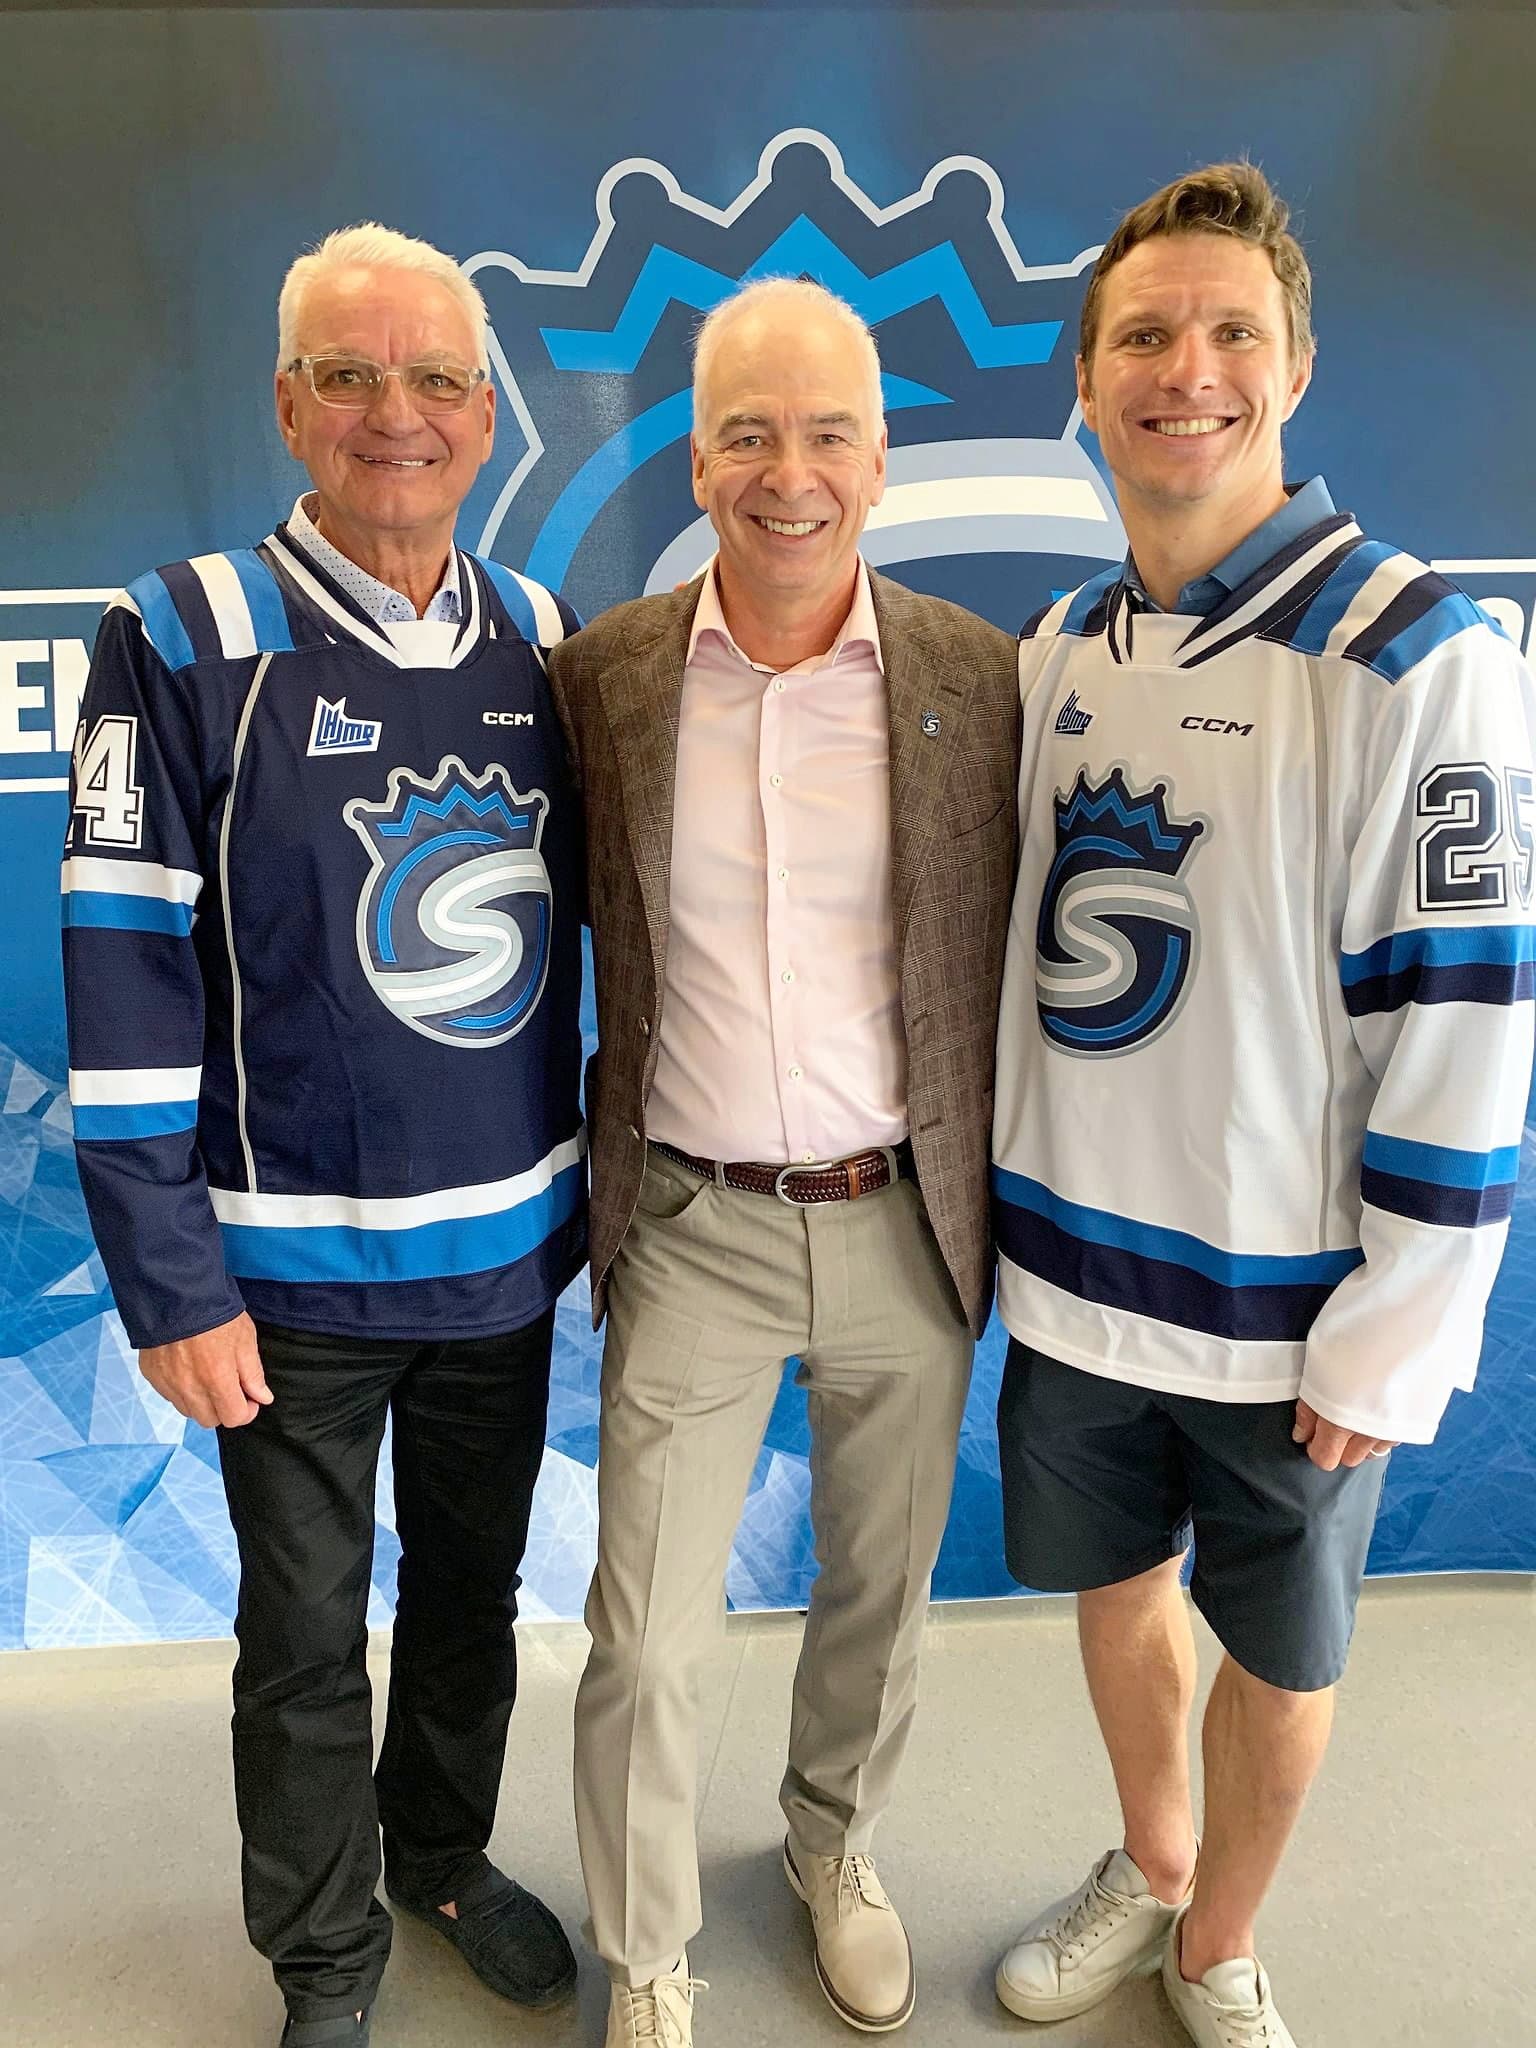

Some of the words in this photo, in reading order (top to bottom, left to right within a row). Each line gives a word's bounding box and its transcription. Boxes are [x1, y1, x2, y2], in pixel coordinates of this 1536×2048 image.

[482, 711, 534, 726] CCM
[1180, 716, 1255, 737] CCM
[64, 714, 145, 850] 4
[1416, 761, 1535, 912] 25
